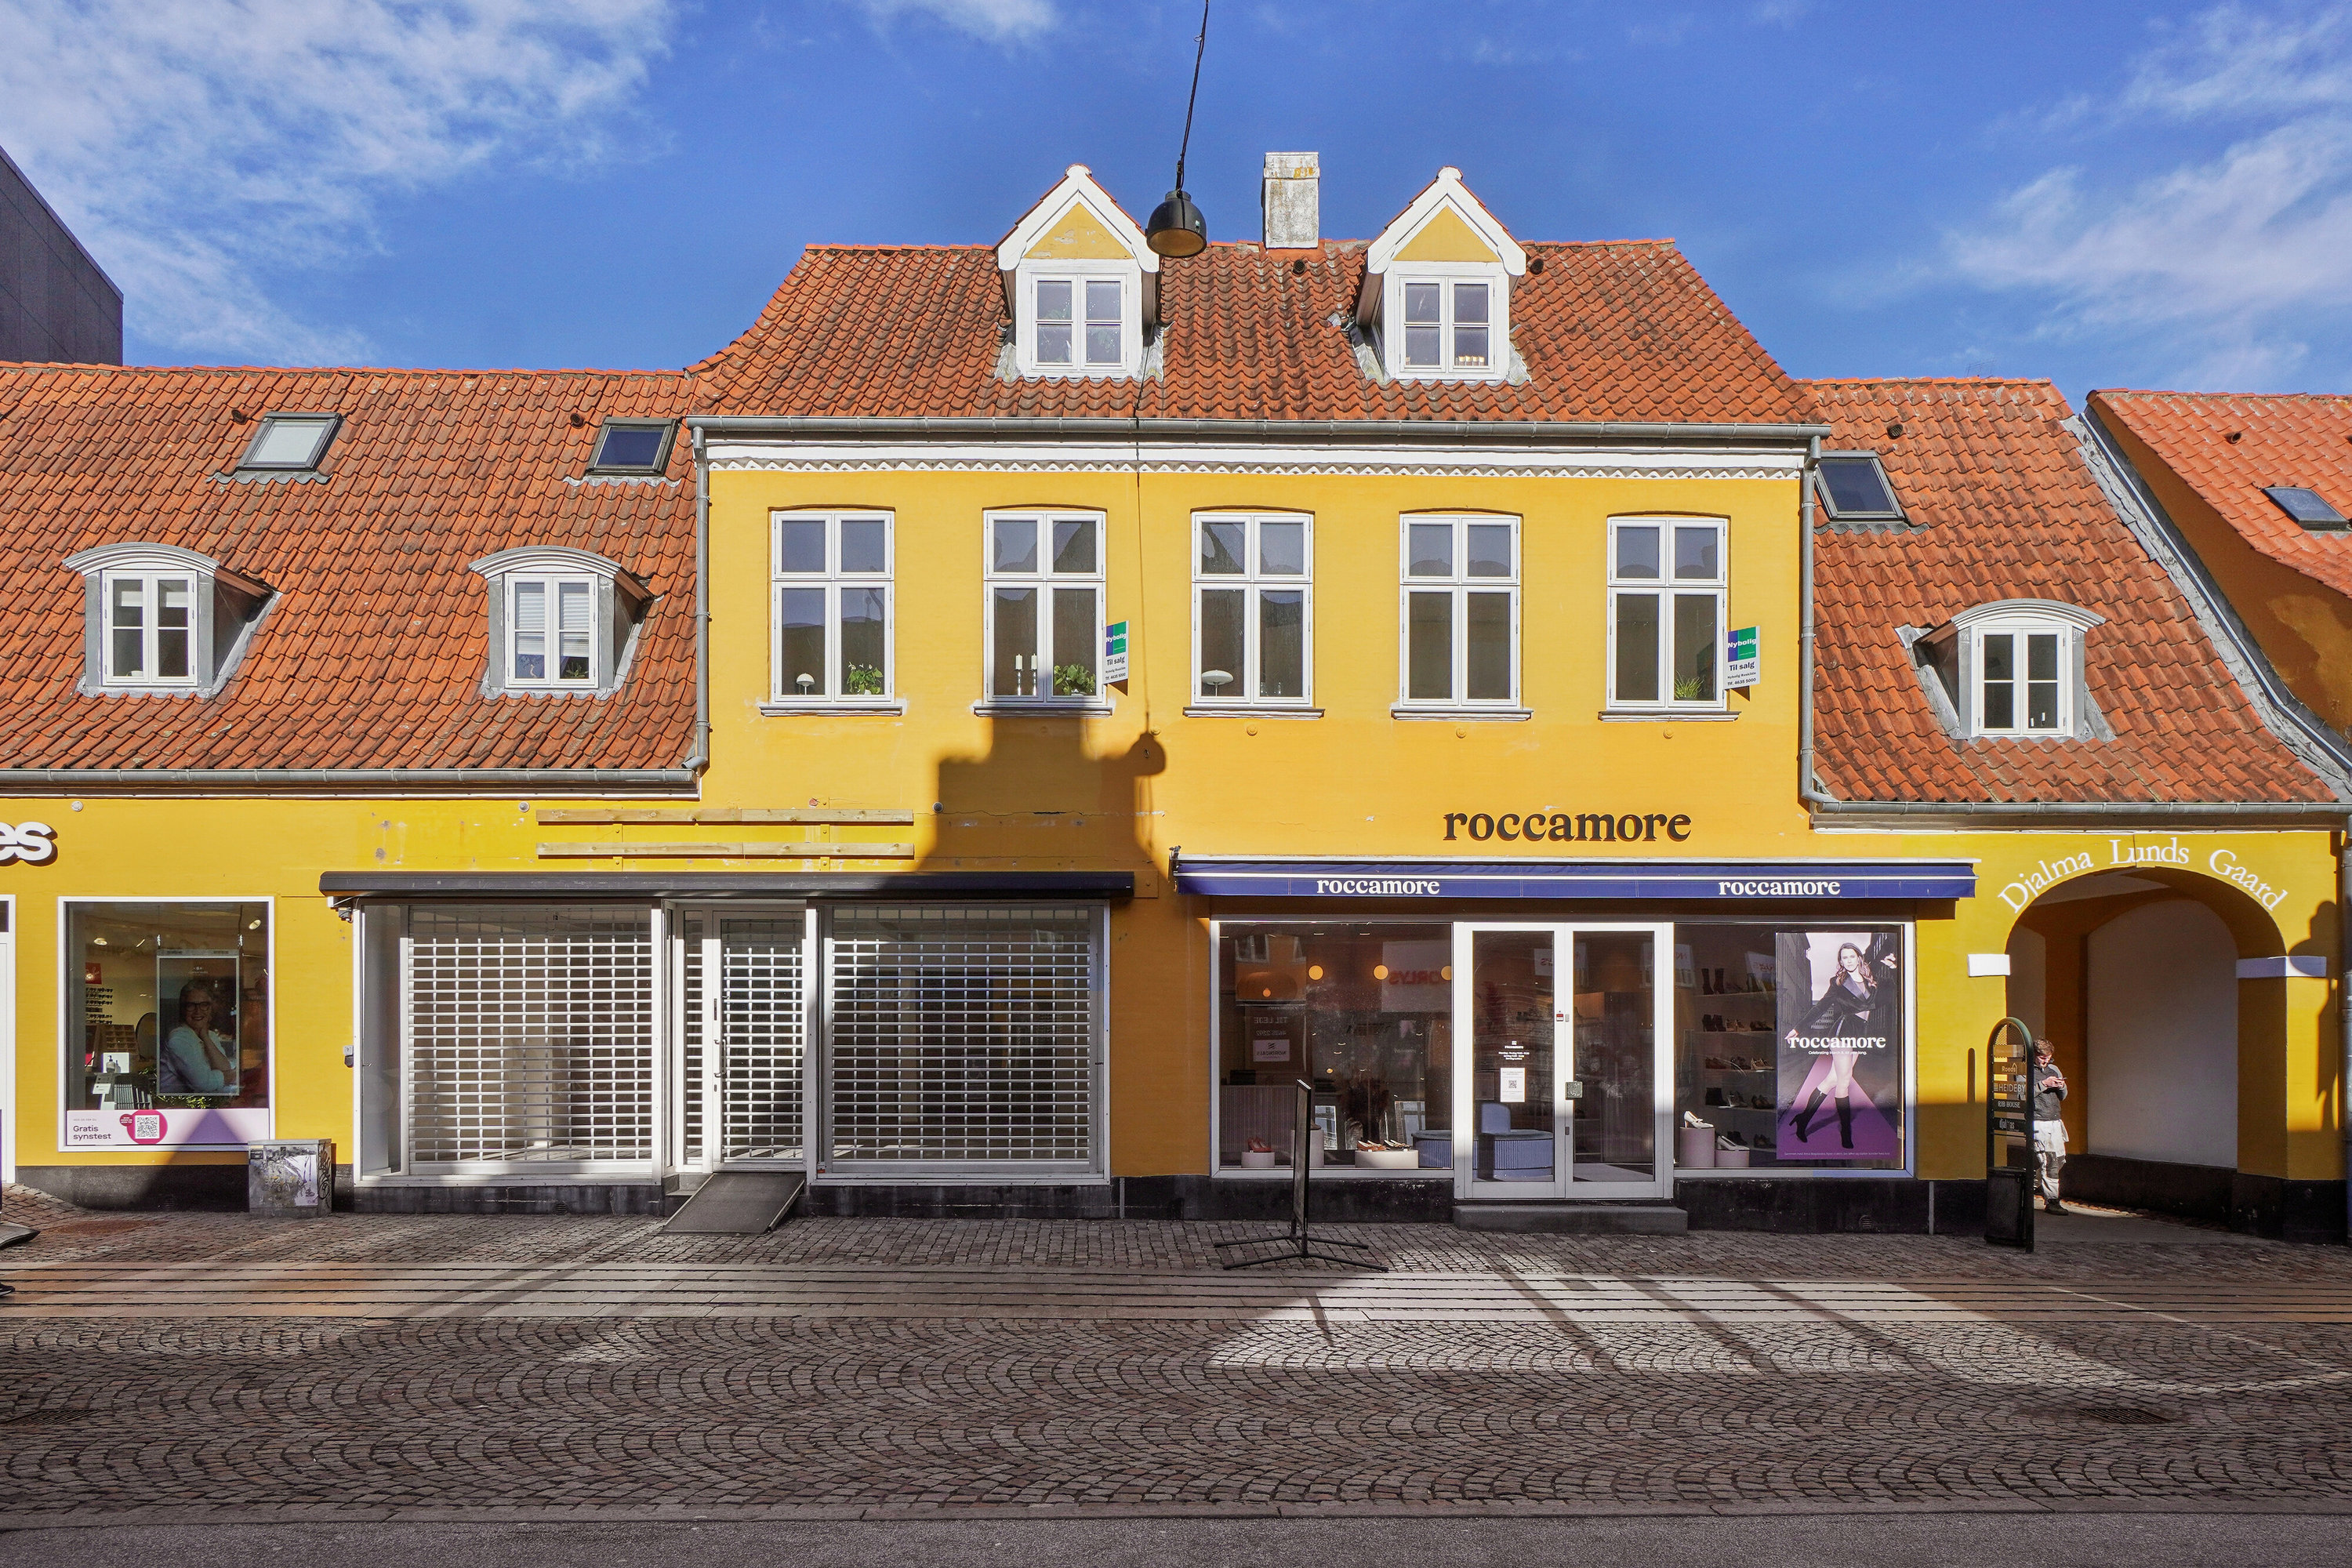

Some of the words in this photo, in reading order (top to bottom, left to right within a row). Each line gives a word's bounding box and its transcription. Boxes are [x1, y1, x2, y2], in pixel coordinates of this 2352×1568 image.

[1105, 633, 1127, 643] Nybolig
[1727, 638, 1756, 648] Nybolig
[1114, 656, 1125, 665] salg
[1739, 661, 1755, 670] salg
[1443, 812, 1692, 842] roccamore
[1998, 851, 2094, 913] Djalma
[2110, 837, 2190, 864] Lunds
[2209, 849, 2288, 911] Gaard
[1317, 878, 1439, 895] roccamore
[1719, 880, 1841, 895] roccamore
[1789, 1036, 1886, 1048] roccamore
[1998, 1083, 2026, 1092] HEIDEBY
